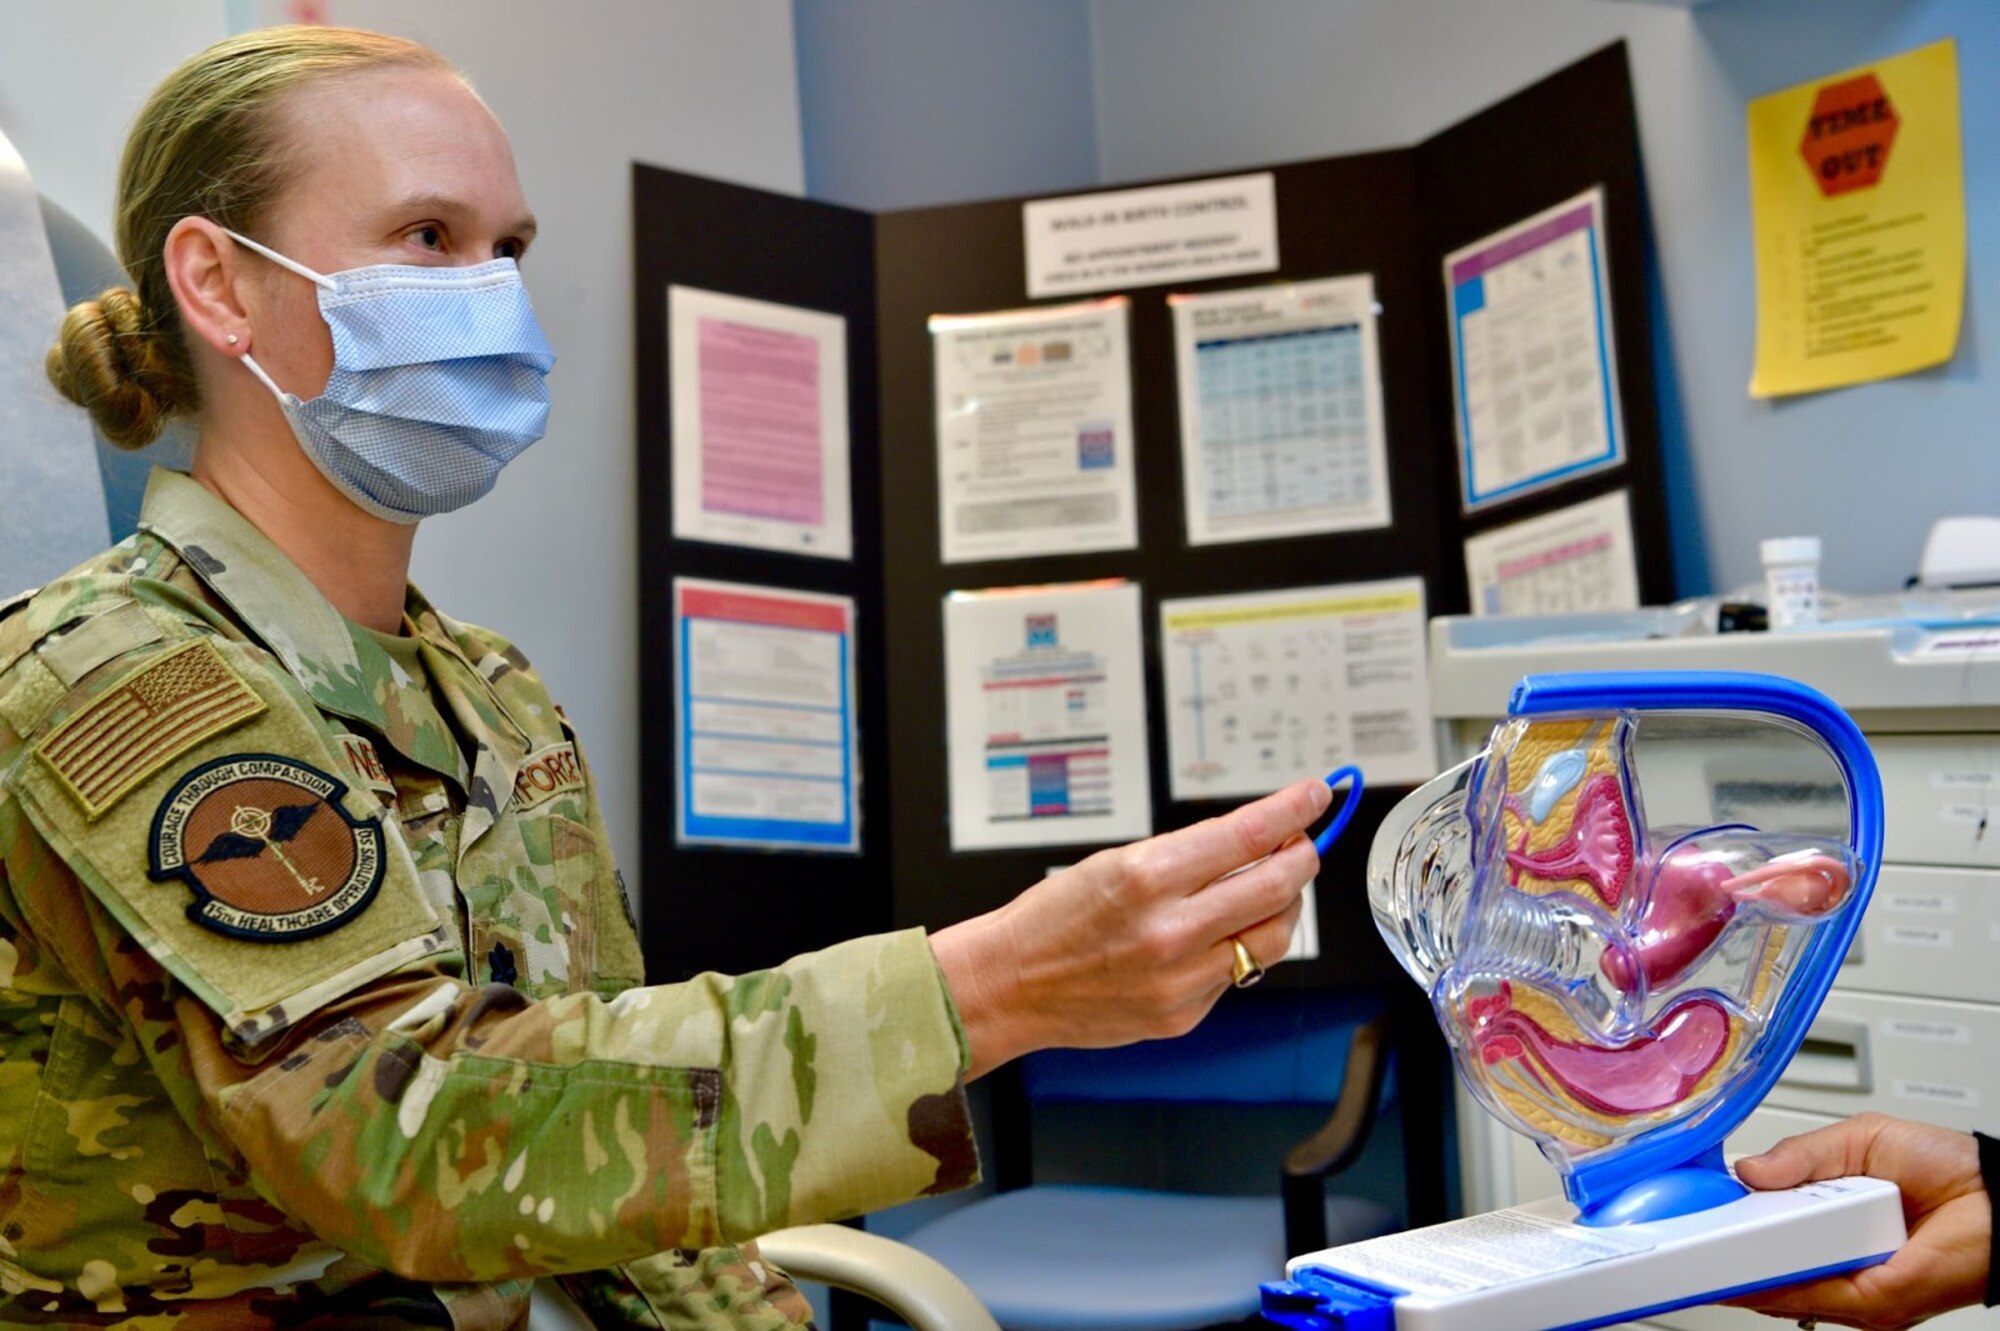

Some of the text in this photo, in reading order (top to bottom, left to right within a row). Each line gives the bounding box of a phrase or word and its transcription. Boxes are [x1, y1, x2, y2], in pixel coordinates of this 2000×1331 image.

[1810, 95, 1889, 140] TIME
[1822, 143, 1880, 180] OUT
[161, 762, 332, 866] COURAGE THROUGH COMPASSION
[237, 905, 335, 933] HEALTHCARE
[332, 847, 375, 911] OPERATIONS
[358, 829, 374, 847] SQ
